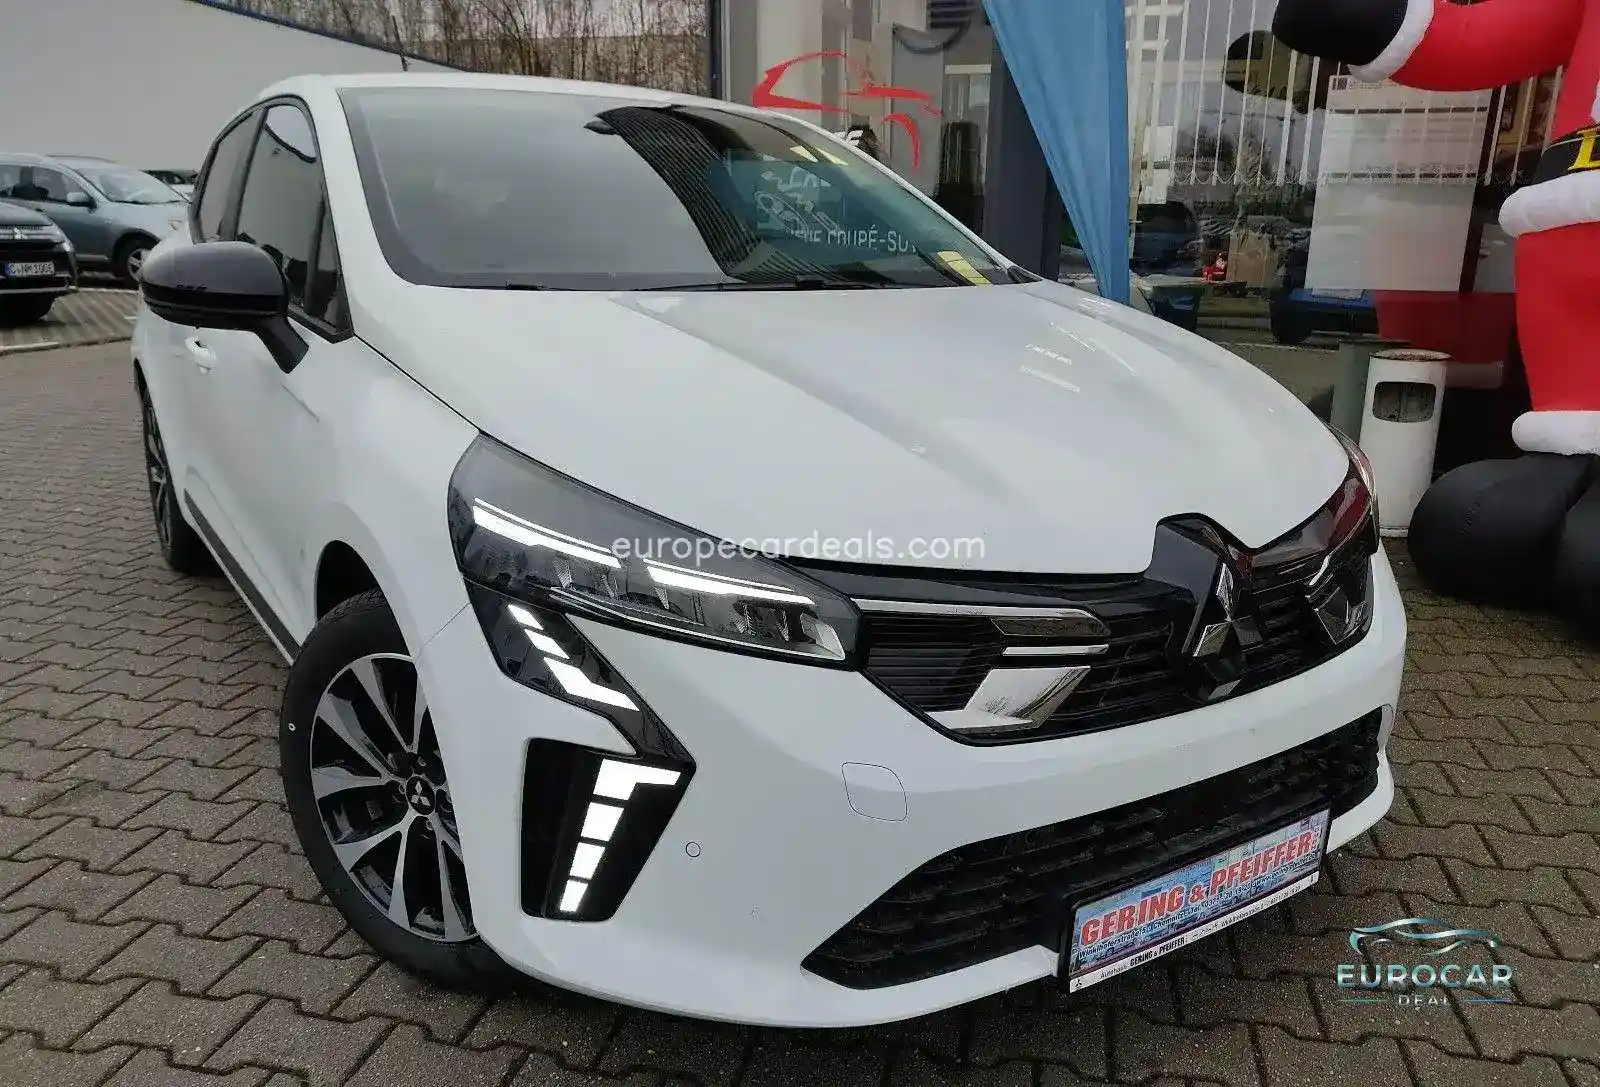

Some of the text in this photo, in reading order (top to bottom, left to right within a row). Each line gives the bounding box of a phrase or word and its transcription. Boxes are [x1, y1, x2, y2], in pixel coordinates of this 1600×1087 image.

[1081, 885, 1186, 946] GERING
[1189, 884, 1207, 904] &
[1210, 831, 1314, 895] PFEIFFER
[1129, 950, 1153, 967] GERING
[1158, 936, 1185, 955] PFEIFFER
